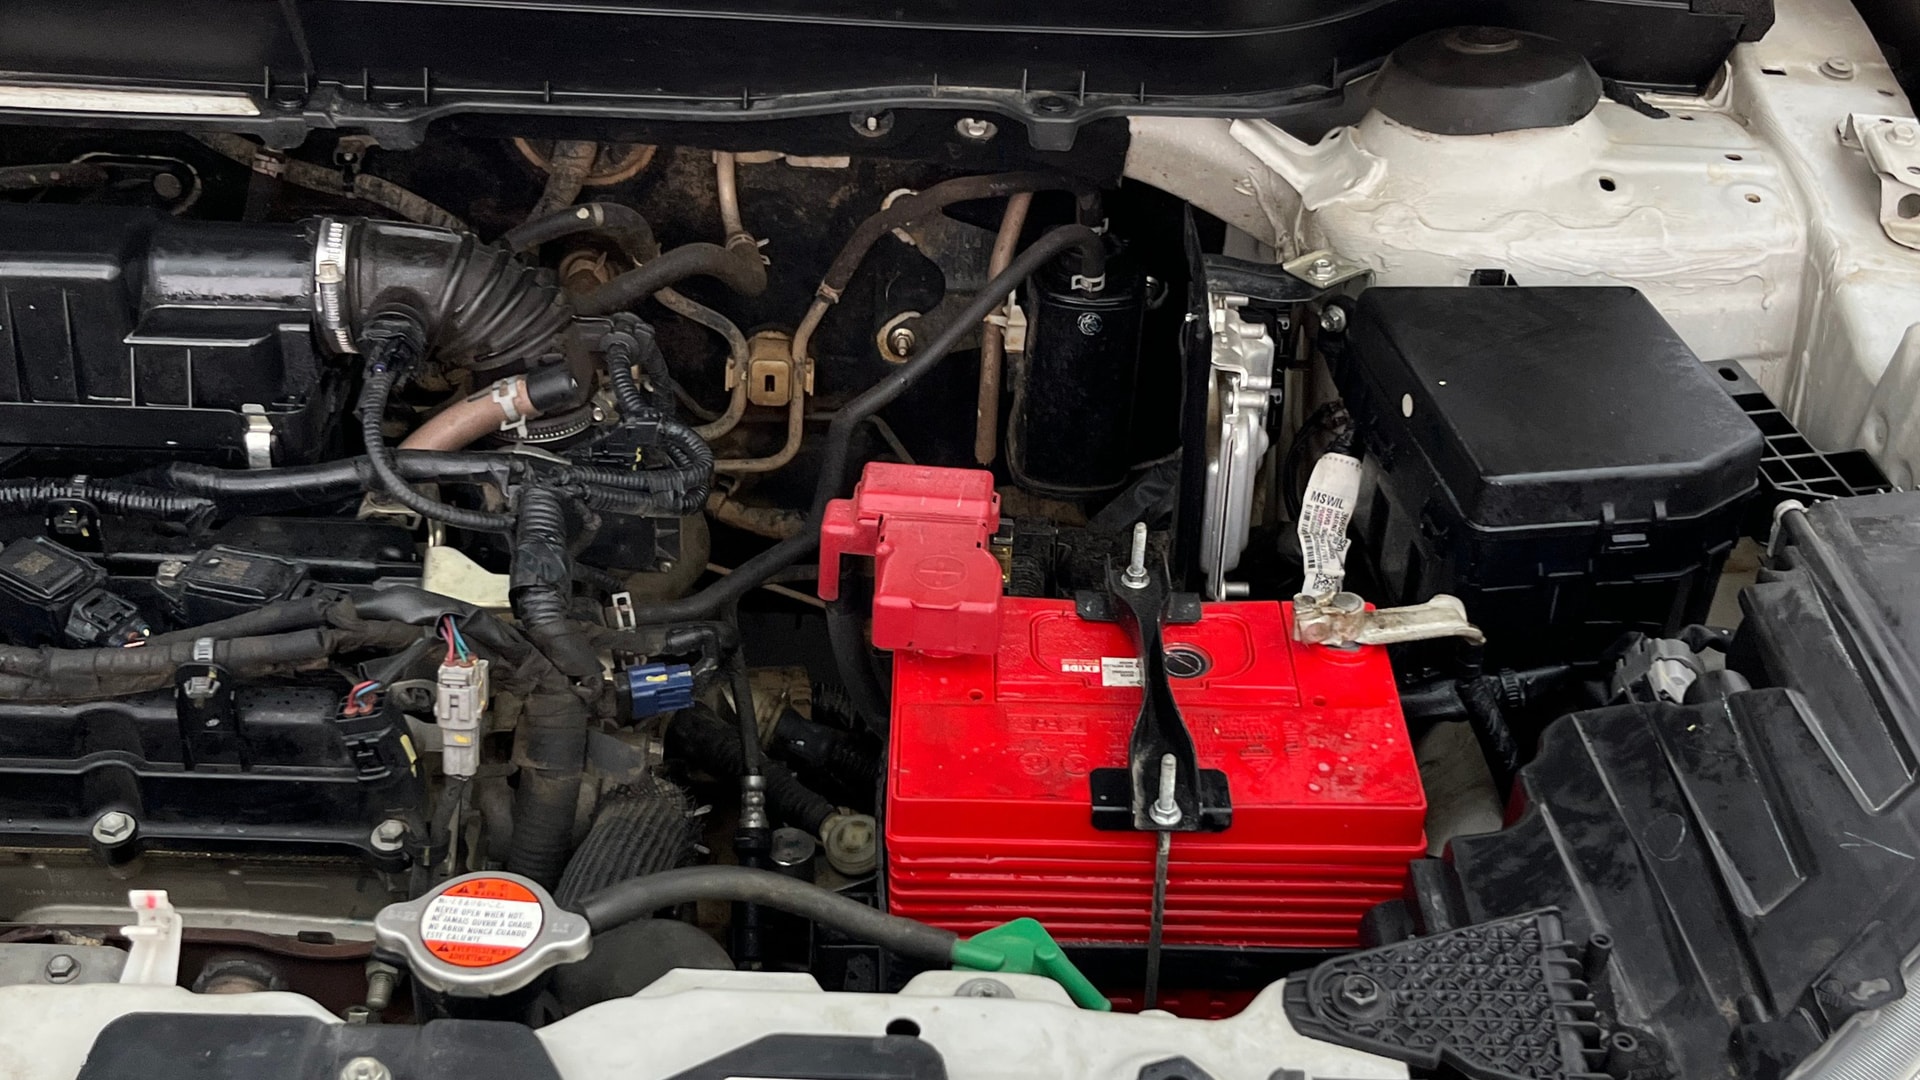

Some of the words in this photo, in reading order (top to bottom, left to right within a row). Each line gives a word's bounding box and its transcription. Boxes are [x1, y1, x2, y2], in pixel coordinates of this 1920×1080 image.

[1311, 491, 1344, 509] MSWIL
[1062, 664, 1100, 673] EXIDE
[434, 906, 458, 914] NEVER
[461, 908, 481, 917] OPEN
[484, 911, 505, 919] WHEN
[443, 916, 470, 925] JAMAIS
[425, 931, 443, 939] ESTE
[446, 933, 480, 943] CALIENTE
[467, 927, 493, 935] NUNCA
[496, 928, 527, 937] CUANDO
